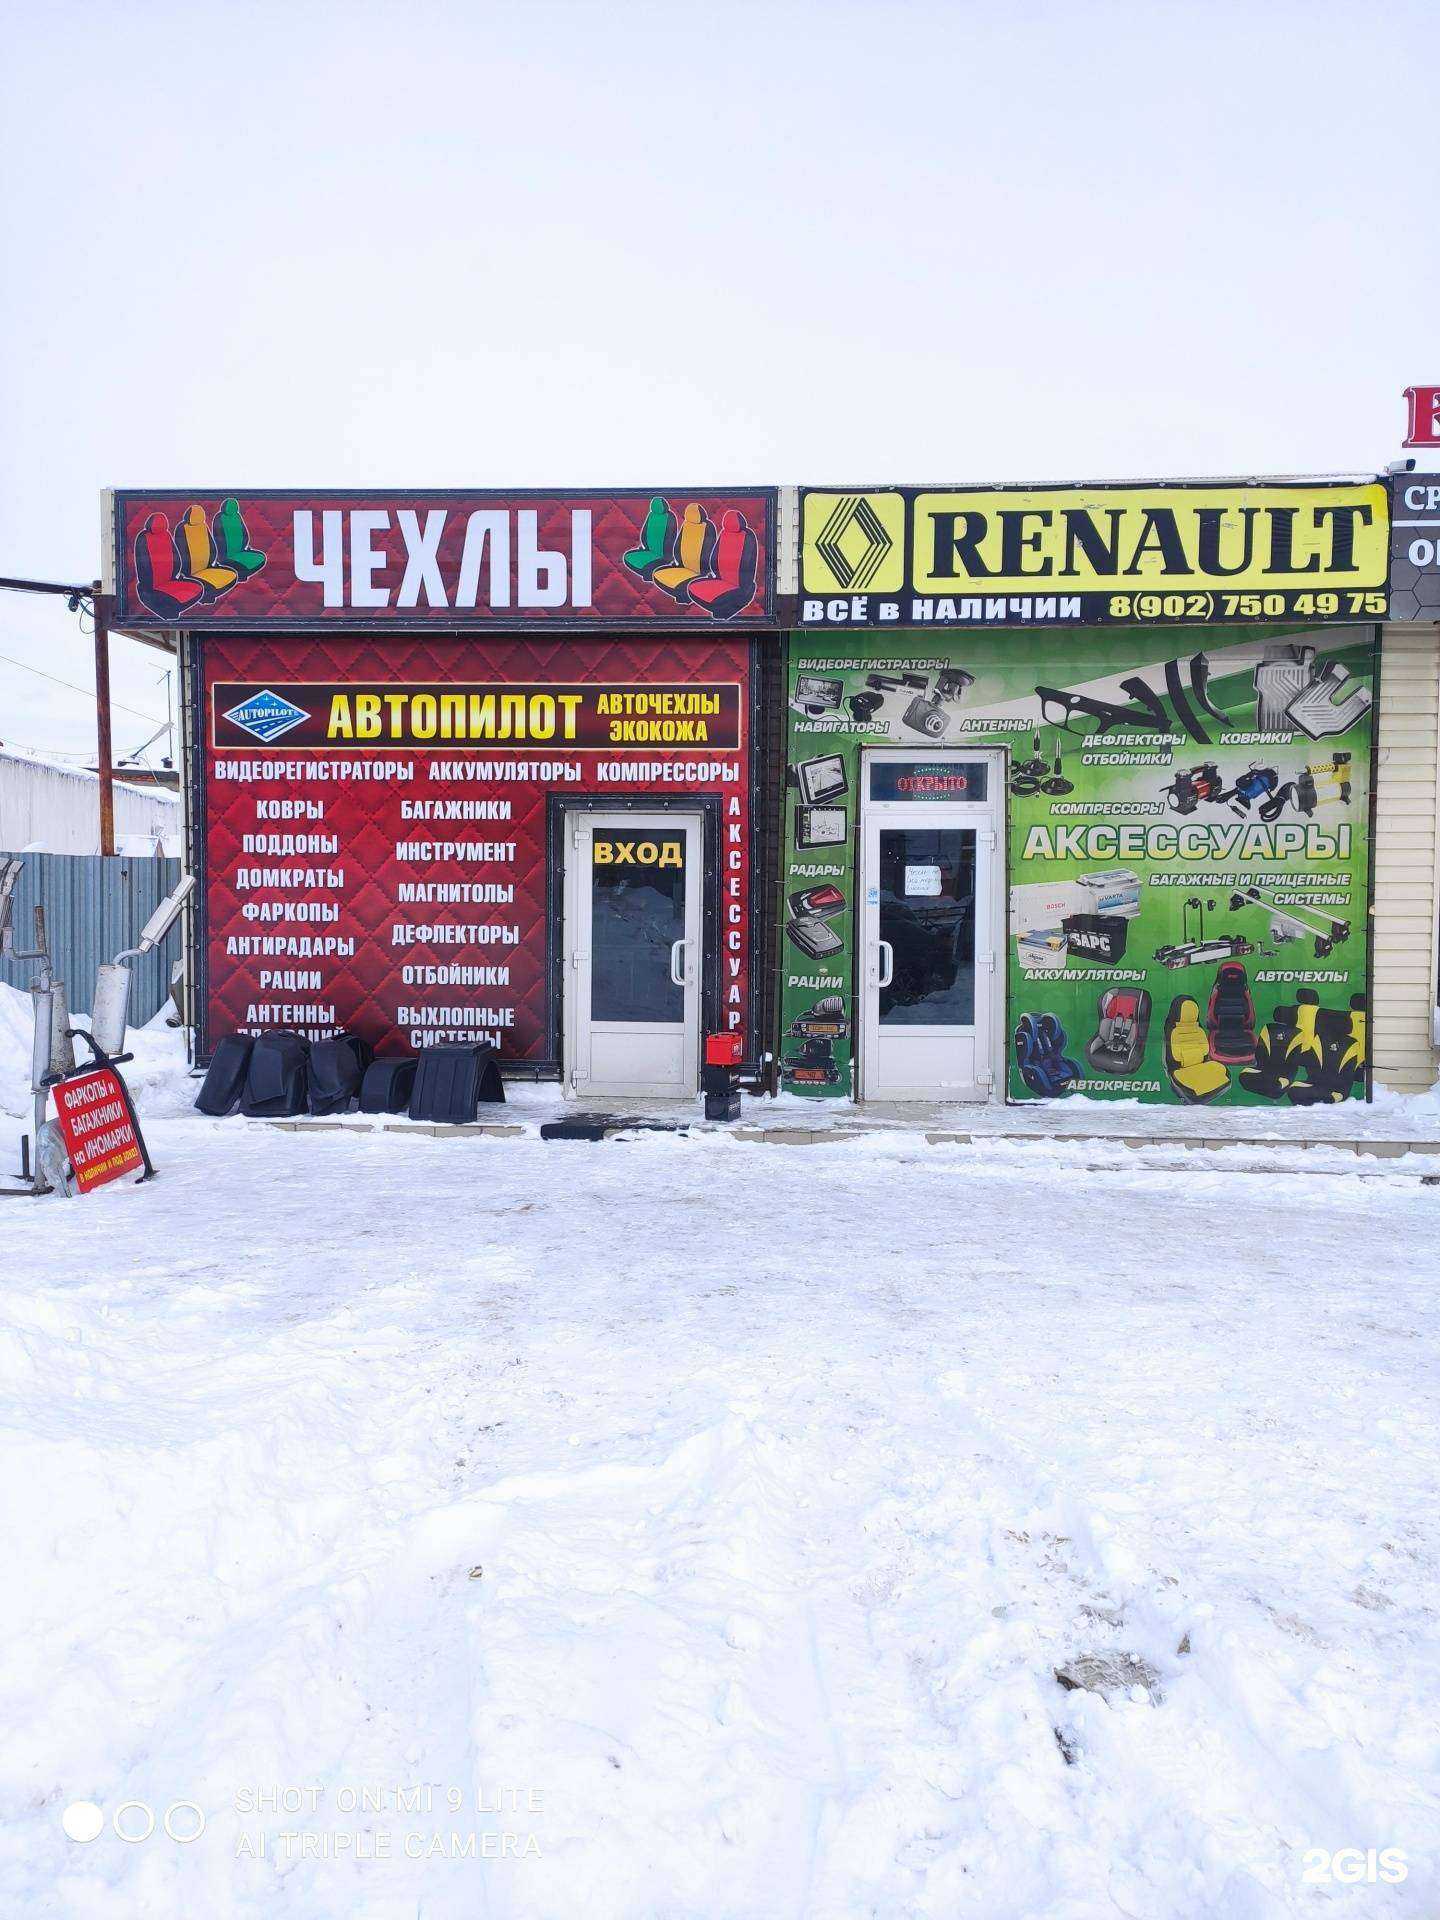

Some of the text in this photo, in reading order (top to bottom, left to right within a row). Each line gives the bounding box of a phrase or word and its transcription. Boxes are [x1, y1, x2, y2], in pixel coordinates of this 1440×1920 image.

[926, 504, 1373, 578] RENAULT
[293, 509, 592, 609] ЧЕХЛЫ
[803, 596, 867, 621] ВСЁ
[912, 597, 1081, 620] НАЛИЧИИ
[1109, 592, 1387, 620] 8(902) 750 49 75
[797, 658, 949, 671] ВИДЕОРЕГИСТРАТОРЫ
[239, 708, 294, 721] AUTOPILOT
[597, 693, 720, 716] АВТОЧЕХЛЫ
[326, 693, 582, 740] АВТОПИЛОТ
[794, 720, 890, 733] НАВИГАТОРЫ
[960, 719, 1033, 732] АНТЕННЫ
[609, 719, 708, 743] ЭКОКОЖА
[1081, 733, 1186, 747] ДЕФЛЕКТОРЫ
[1219, 732, 1293, 745] КОВРИКИ
[1081, 751, 1173, 766] ОТБОЙНИКИ
[215, 760, 740, 783] ВИДЕОРЕГИСТРАТОРЫ АККУМУЛЯТОРЫ КОМПРЕССОРЫ
[896, 776, 968, 791] ОТКРЫТО
[256, 800, 324, 820] КОВРЫ
[400, 800, 512, 820] БАГАЖНИКИ
[1050, 802, 1164, 815] КОМПРЕССОРЫ
[242, 834, 338, 856] ПОДДОНЫ
[395, 842, 517, 862] ИНСТРУМЕНТ
[1022, 824, 1351, 860] АКСЕССУАРЫ
[593, 842, 683, 868] ВХОД
[236, 868, 344, 890] ДОМКРАТЫ
[789, 864, 845, 876] РАДАРЫ
[1149, 874, 1350, 888] БАГАЖНЫЕ И ПРИЦЕПНЫЕ
[398, 883, 514, 903] МАГНИТОЛЫ
[1273, 892, 1351, 905] СИСТЕМЫ
[242, 902, 339, 922] ФАРКОПЫ
[1046, 902, 1066, 910] BOSCH
[392, 924, 519, 946] ДЕФЛЕКТОРЫ
[226, 936, 355, 958] АНТИРАДАРЫ
[260, 970, 322, 992] РАЦИИ
[402, 963, 510, 986] ОТБОЙНИКИ
[788, 975, 843, 990] РАЦИИ
[1024, 969, 1147, 982] АККУМУЛЯТОРЫ
[1255, 971, 1348, 983] АВТОЧЕХЛЫ
[246, 1004, 335, 1024] АНТЕННЫ
[397, 1006, 515, 1027] ВЫХЛОПНЫЕ
[64, 1079, 108, 1109] ФАРКОПЫ
[1067, 1079, 1161, 1092] АВТОКРЕСЛА
[70, 1100, 124, 1136] БАГАЖНИКИ
[84, 1124, 134, 1160] ИНОМАРКИ
